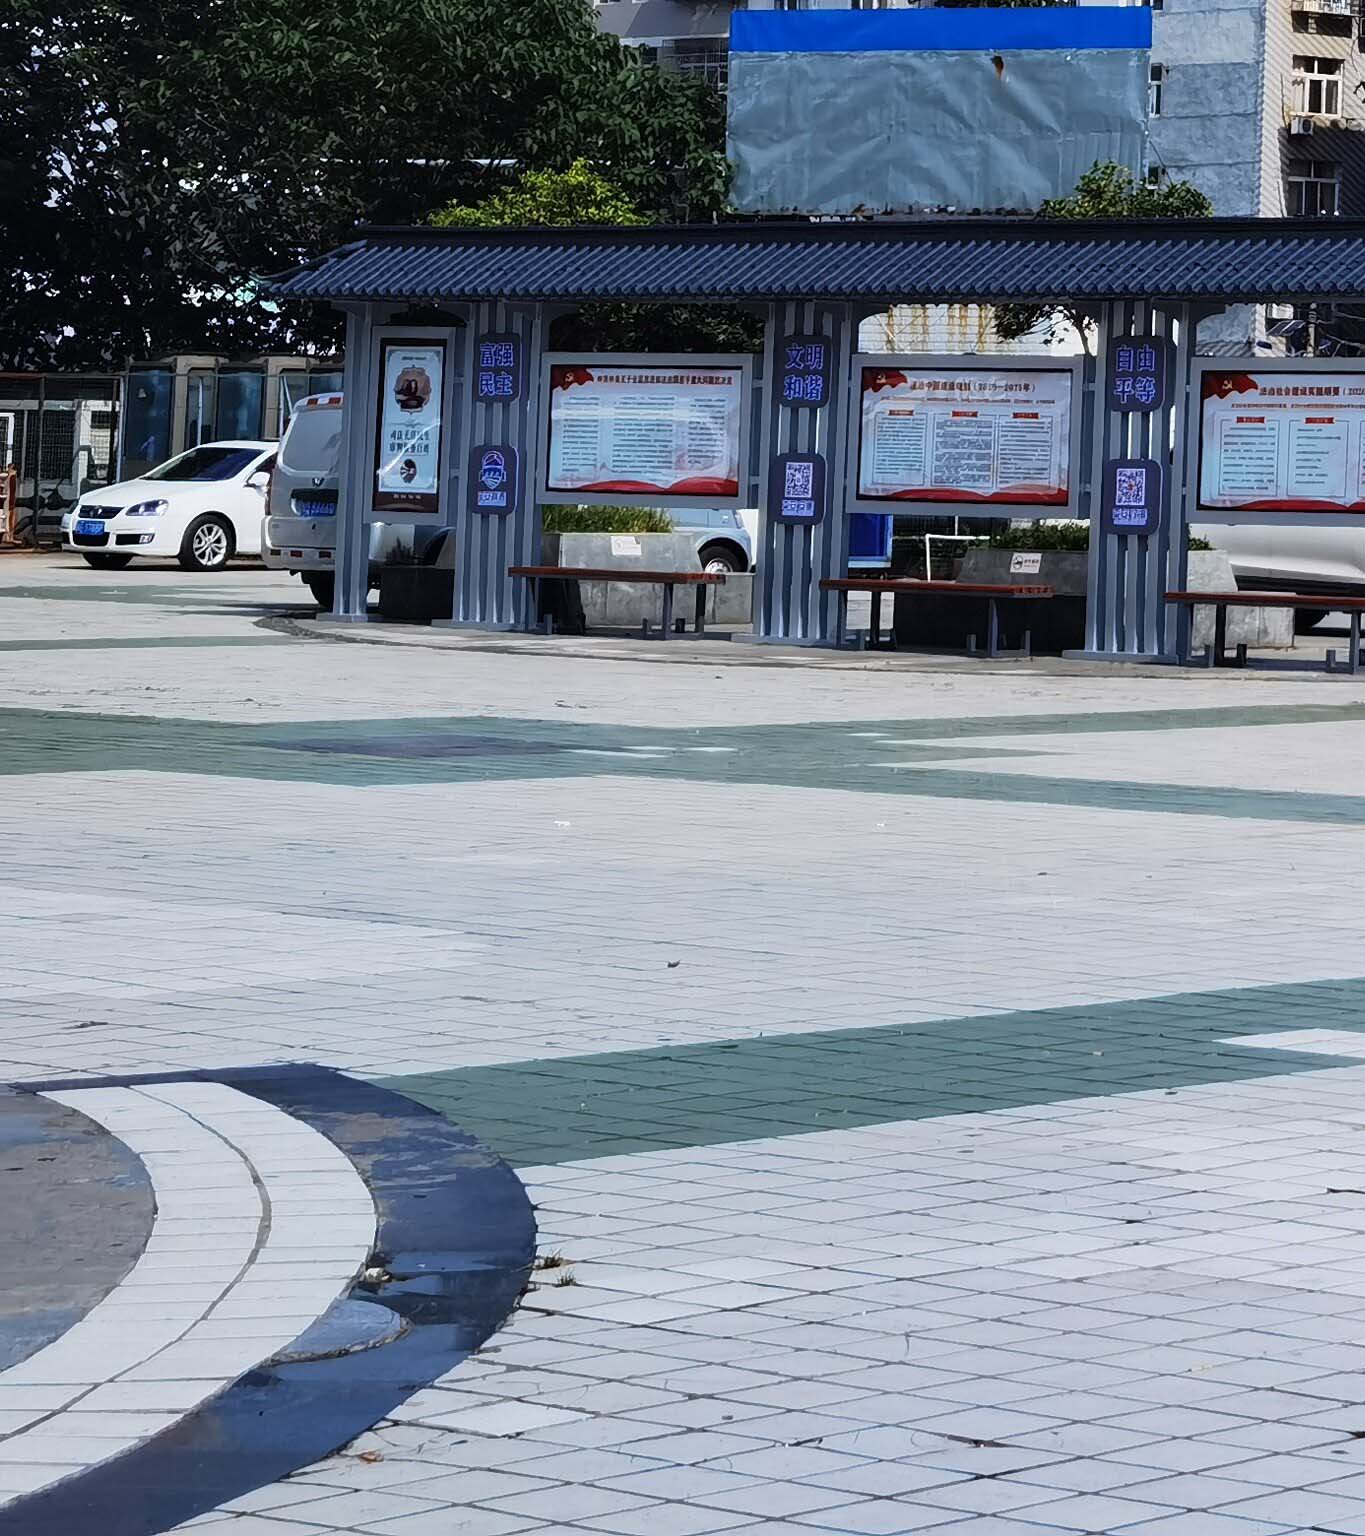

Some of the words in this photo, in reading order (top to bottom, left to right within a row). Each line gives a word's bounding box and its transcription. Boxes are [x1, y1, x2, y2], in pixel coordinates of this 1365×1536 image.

[480, 342, 513, 368] 富强
[784, 343, 824, 370] 文明
[1115, 344, 1156, 373] 自由
[479, 371, 513, 397] 民主
[783, 375, 824, 401] 和谐
[1113, 376, 1156, 405] 平等
